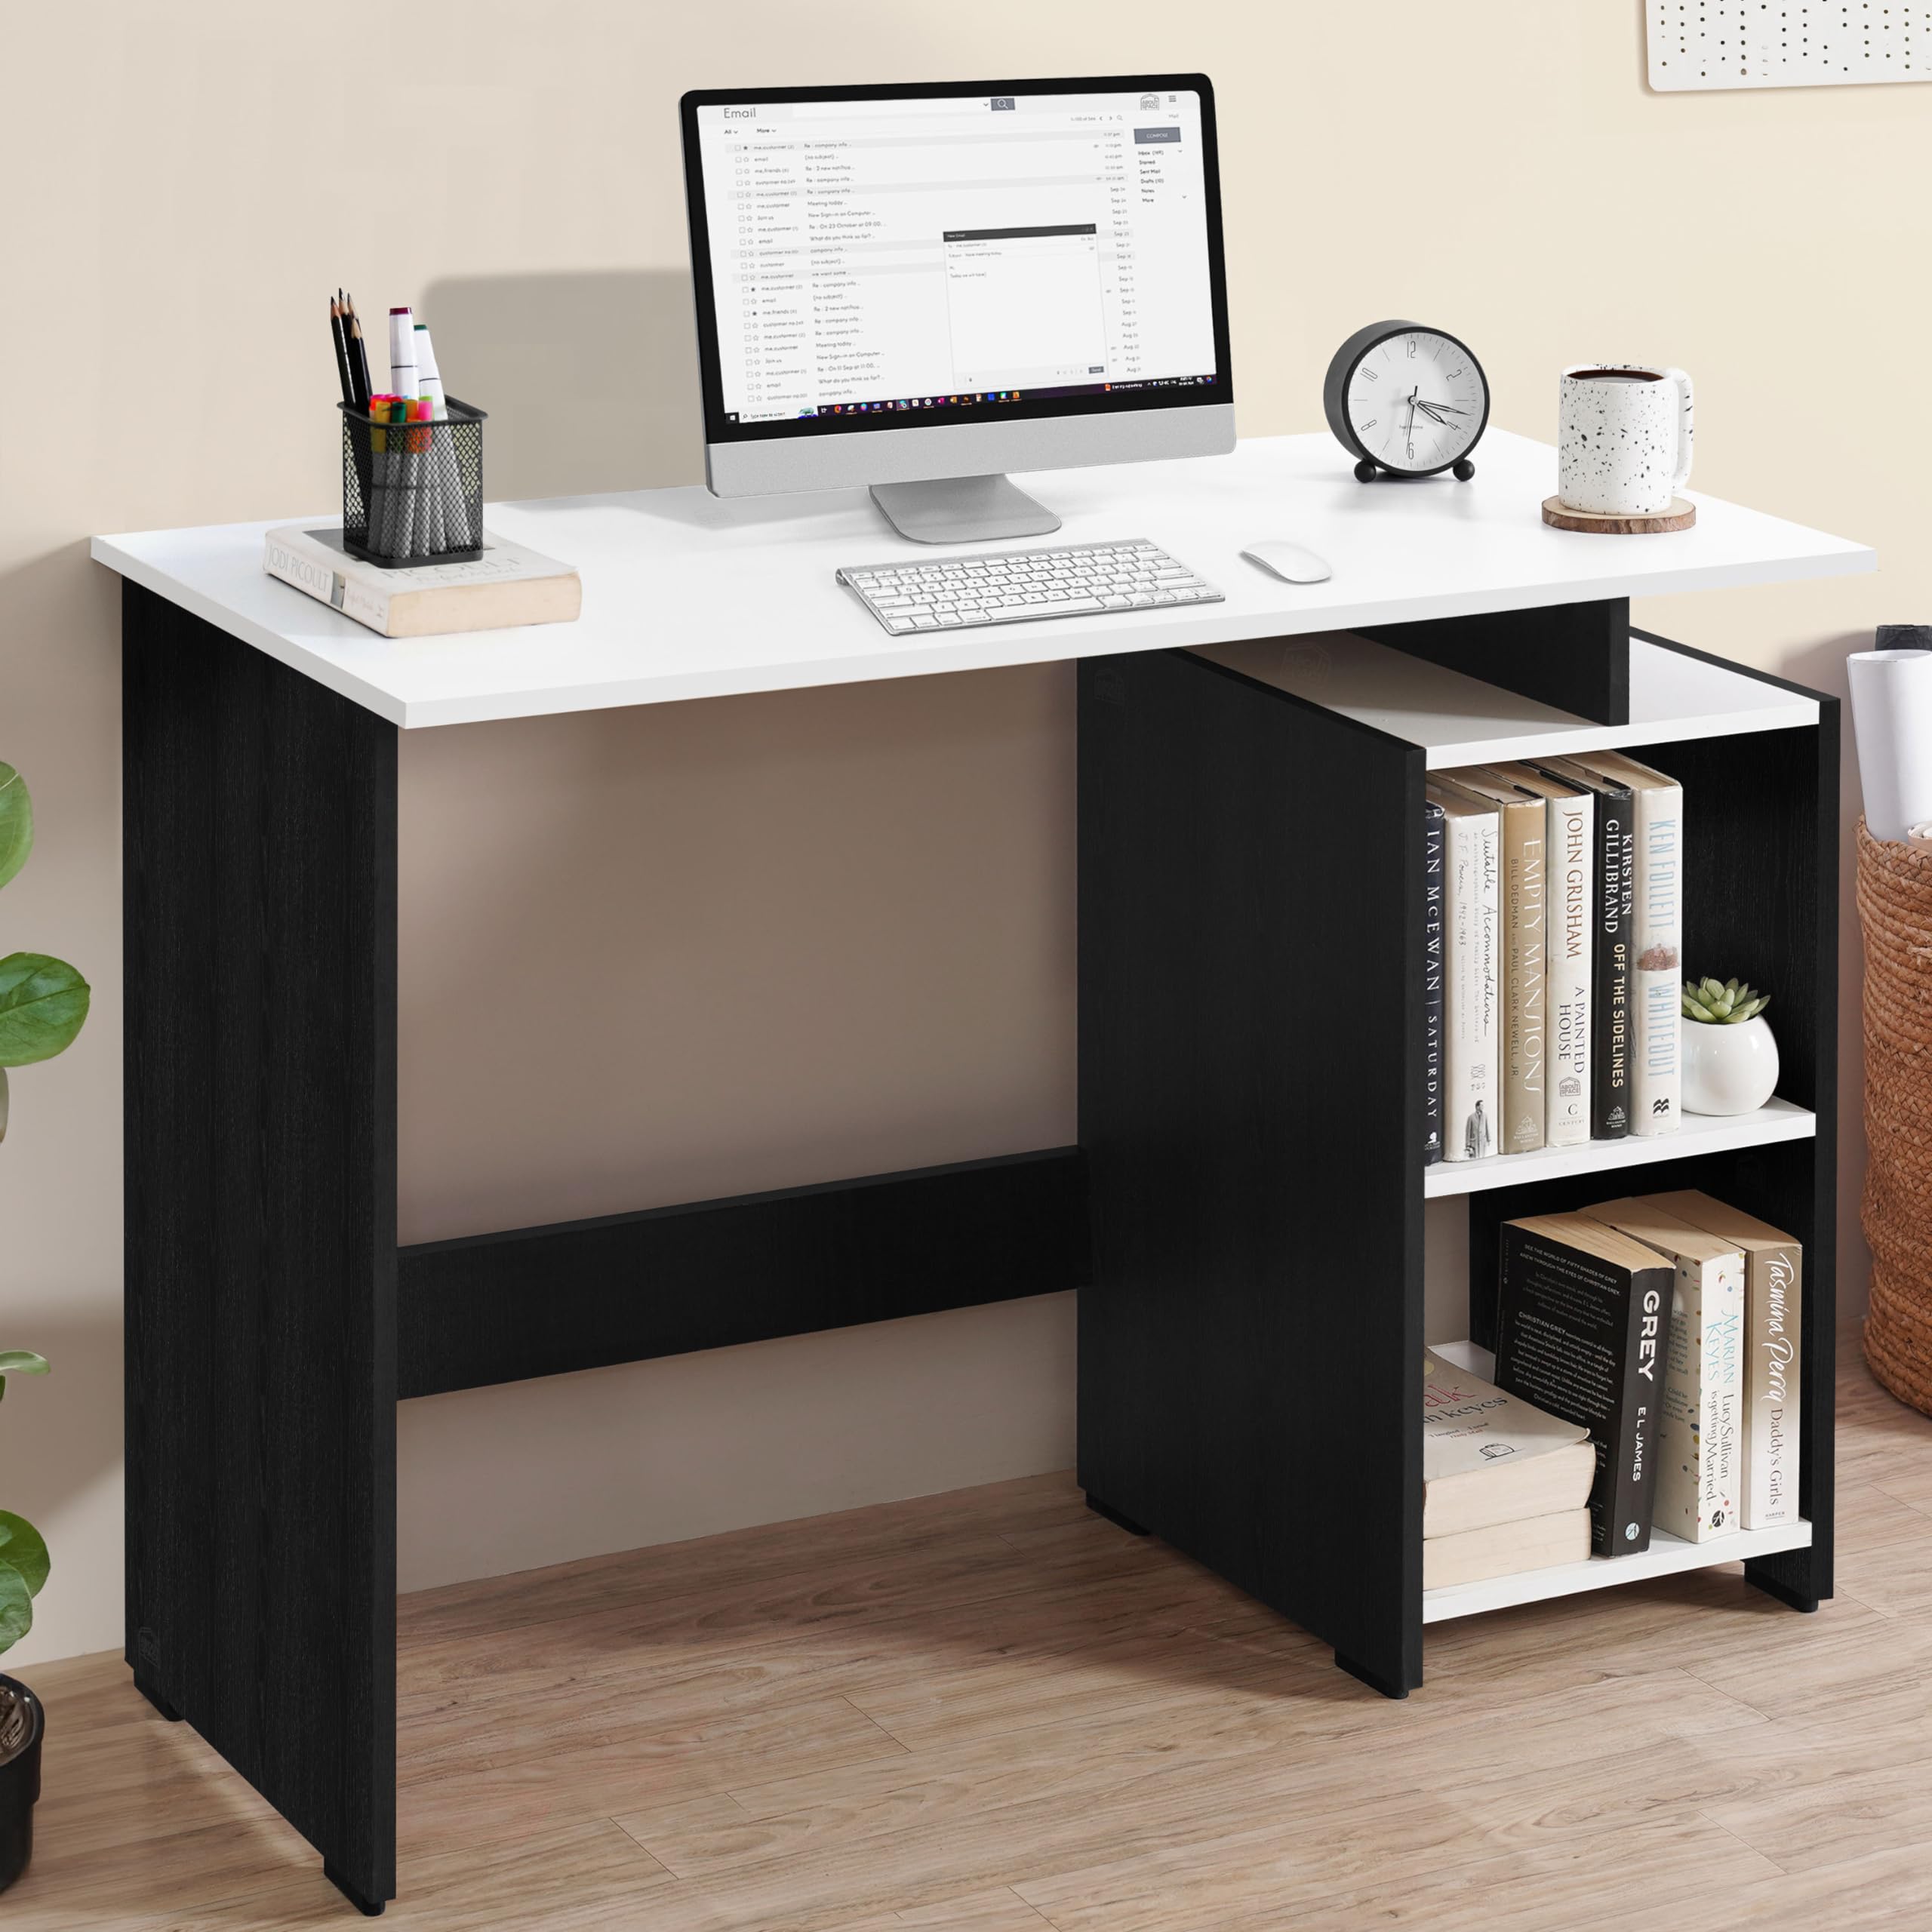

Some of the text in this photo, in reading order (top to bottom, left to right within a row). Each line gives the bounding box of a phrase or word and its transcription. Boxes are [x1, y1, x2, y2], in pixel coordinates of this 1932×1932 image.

[724, 107, 756, 119] Email
[1407, 340, 1417, 358] 12
[1445, 368, 1463, 382] 2
[1360, 419, 1377, 432] 8
[1446, 420, 1461, 431] 4
[1407, 441, 1414, 460] 6
[267, 543, 329, 592] JODI PICOULT
[1426, 830, 1441, 874] IAN
[1511, 859, 1519, 881] BILL
[1621, 833, 1632, 915] KIRSTEN
[1648, 819, 1676, 929] KEN FOLLETT
[1562, 811, 1583, 959] JOHN GRISHAM
[1604, 819, 1620, 934] GILLIBRAND
[1458, 901, 1469, 946] 1942-1963
[1511, 886, 1519, 929] DEDMAN
[1481, 828, 1498, 1037] Suitable Accommodations
[1511, 948, 1519, 973] PAUL
[1523, 838, 1542, 1092] EMPTY MANSIONS
[1511, 978, 1519, 1011] CLARK
[1612, 943, 1626, 1088] OFF THE SIDELINES
[1511, 1016, 1520, 1060] NEWELL,
[1558, 1004, 1571, 1060] HOUSE
[1574, 987, 1586, 1073] A PAINTED
[1647, 982, 1675, 1077] WHITEOUT
[1426, 1014, 1438, 1118] SATURDAY
[1567, 1103, 1578, 1115] C
[1534, 1257, 1556, 1270] THROUGH
[1565, 1269, 1577, 1278] EYES
[1583, 1276, 1607, 1291] CHRISTIAN
[1567, 1260, 1580, 1269] FIFTY
[1580, 1266, 1598, 1277] SHADES
[1604, 1275, 1618, 1284] GREY
[1518, 1311, 1566, 1335] CHRISTIAN GREY
[1638, 1290, 1660, 1382] GREY
[1721, 1309, 1740, 1383] MARIAN
[1761, 1252, 1795, 1402] Tasmina Perry
[1706, 1321, 1723, 1381] KEYES
[1438, 1397, 1508, 1418] keyes
[1632, 1406, 1646, 1482] E L JAMES
[1767, 1408, 1783, 1506] Daddy's Girls
